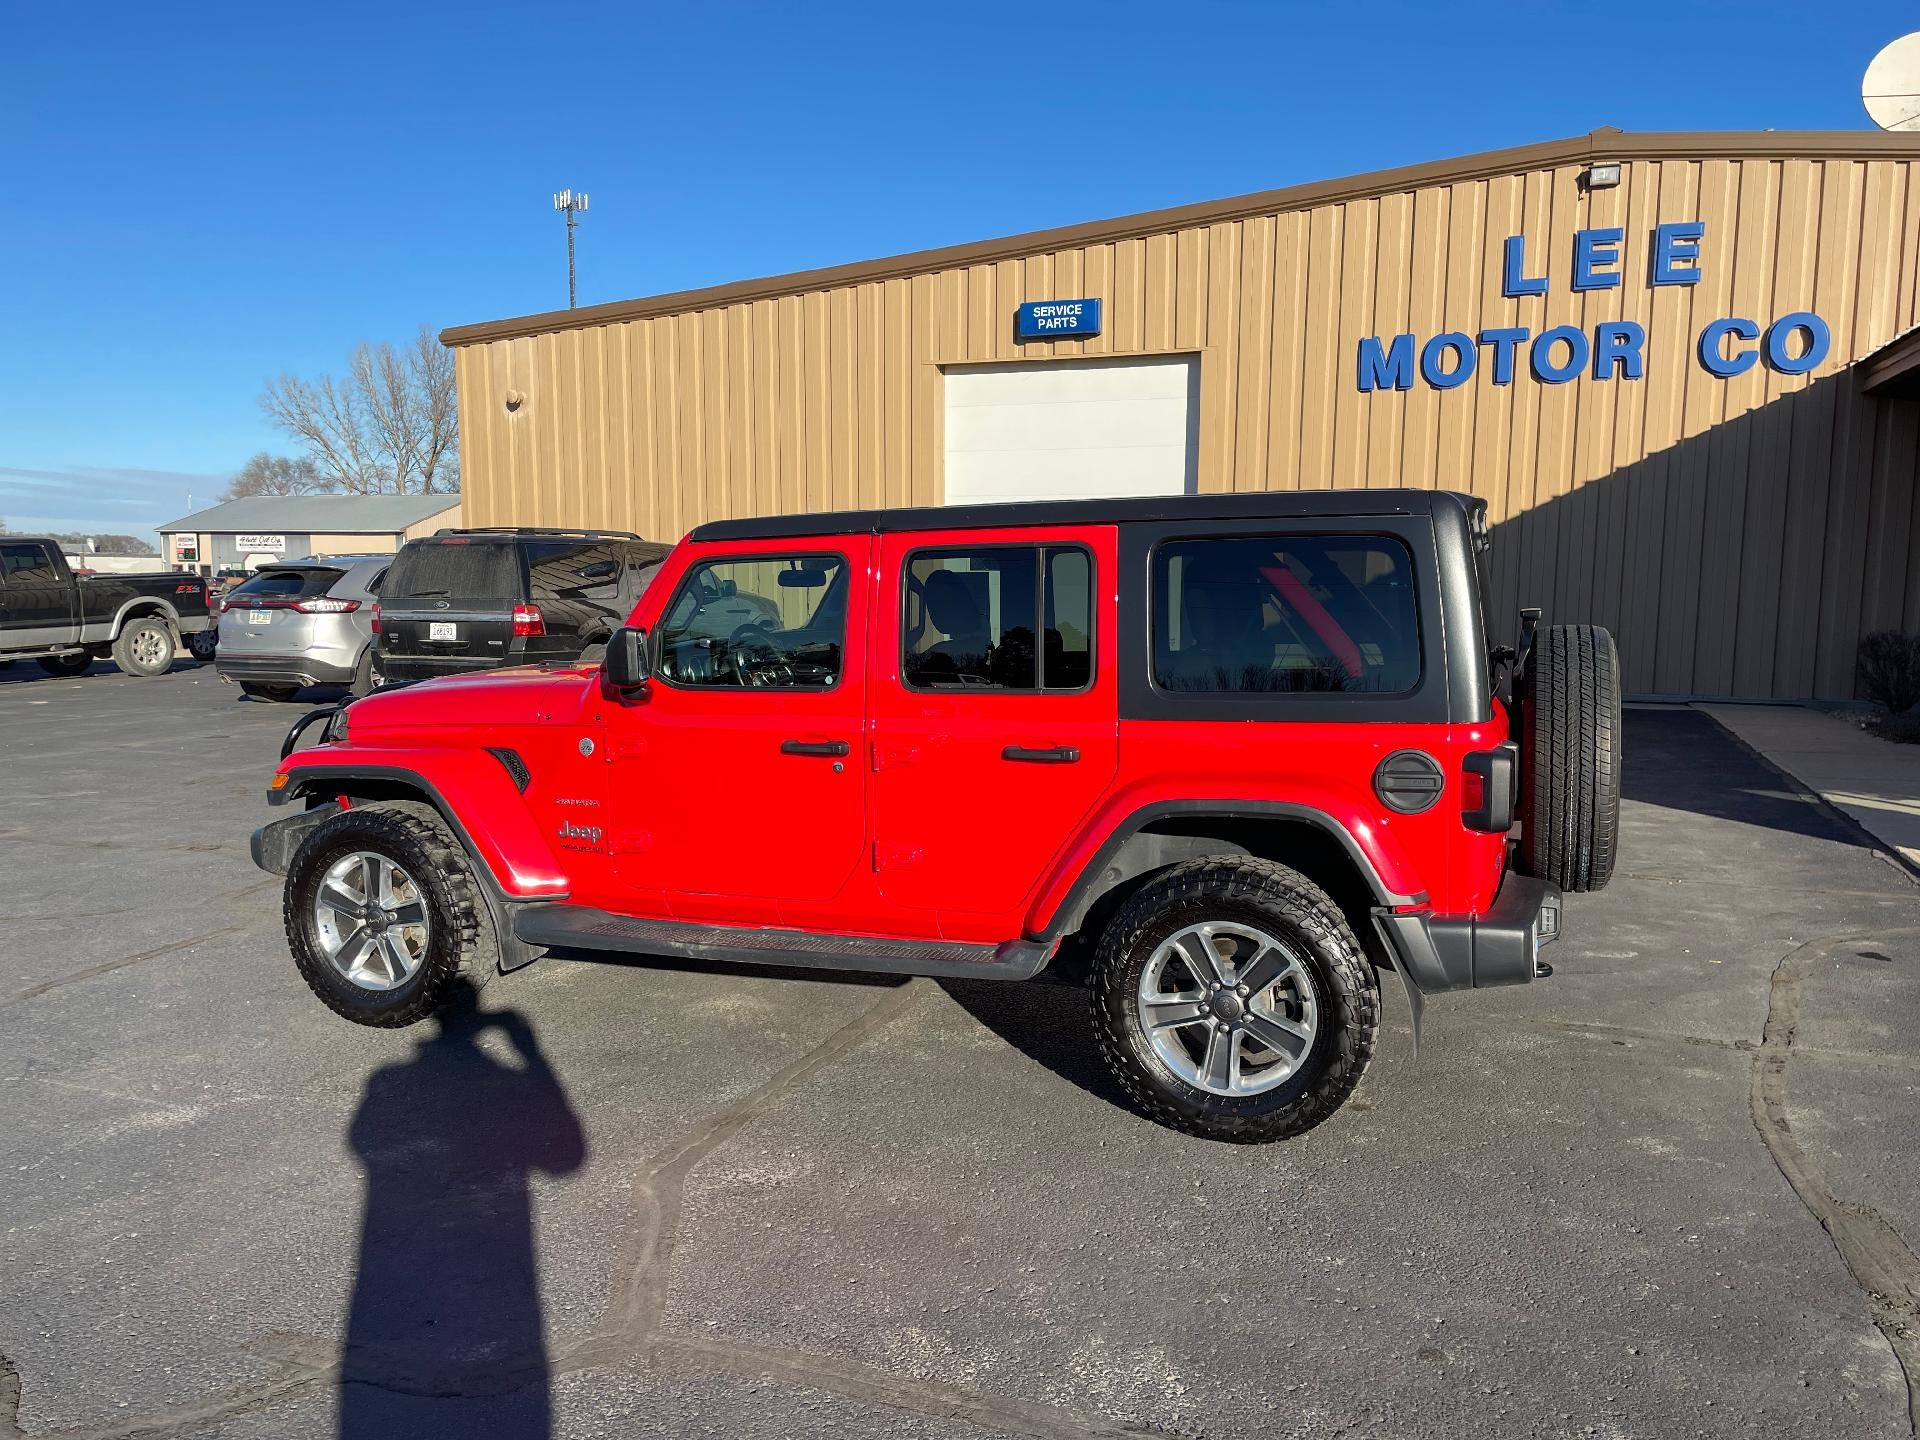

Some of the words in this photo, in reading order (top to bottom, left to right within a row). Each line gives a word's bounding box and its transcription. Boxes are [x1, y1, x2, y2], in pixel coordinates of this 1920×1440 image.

[1503, 221, 1705, 297] LEE
[1033, 304, 1082, 317] SERVICE
[1038, 317, 1077, 329] PARTS
[1357, 320, 1646, 392] MOTOR
[1700, 312, 1831, 379] CO
[176, 584, 200, 592] FX4
[557, 820, 602, 844] Jeep
